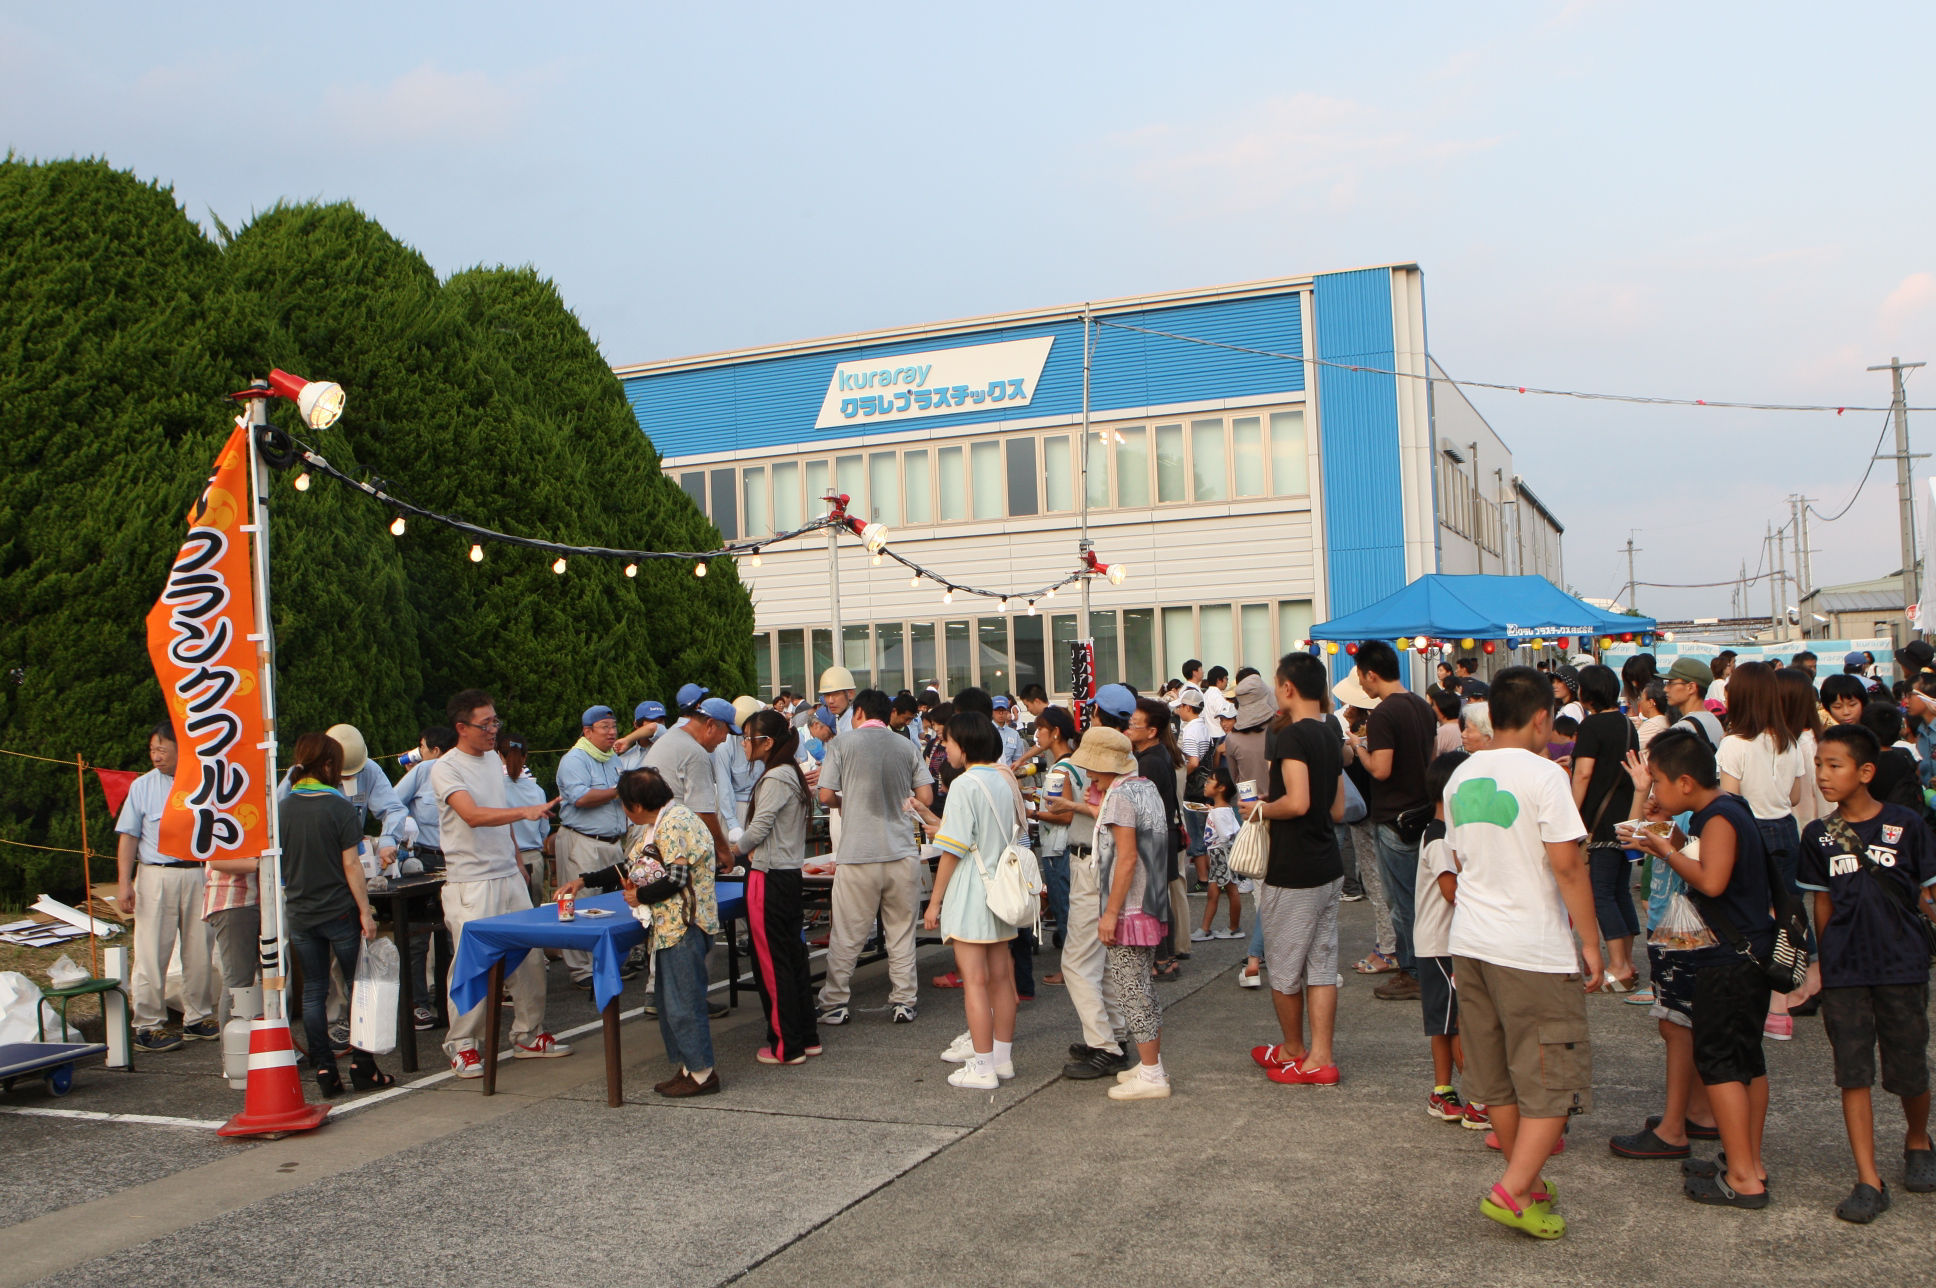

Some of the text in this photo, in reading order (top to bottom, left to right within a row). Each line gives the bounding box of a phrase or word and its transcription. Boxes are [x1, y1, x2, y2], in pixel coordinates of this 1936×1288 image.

[839, 363, 932, 391] kuraray
[840, 378, 1027, 418] クラレプラスチックス
[163, 465, 249, 858] フランクフルト
